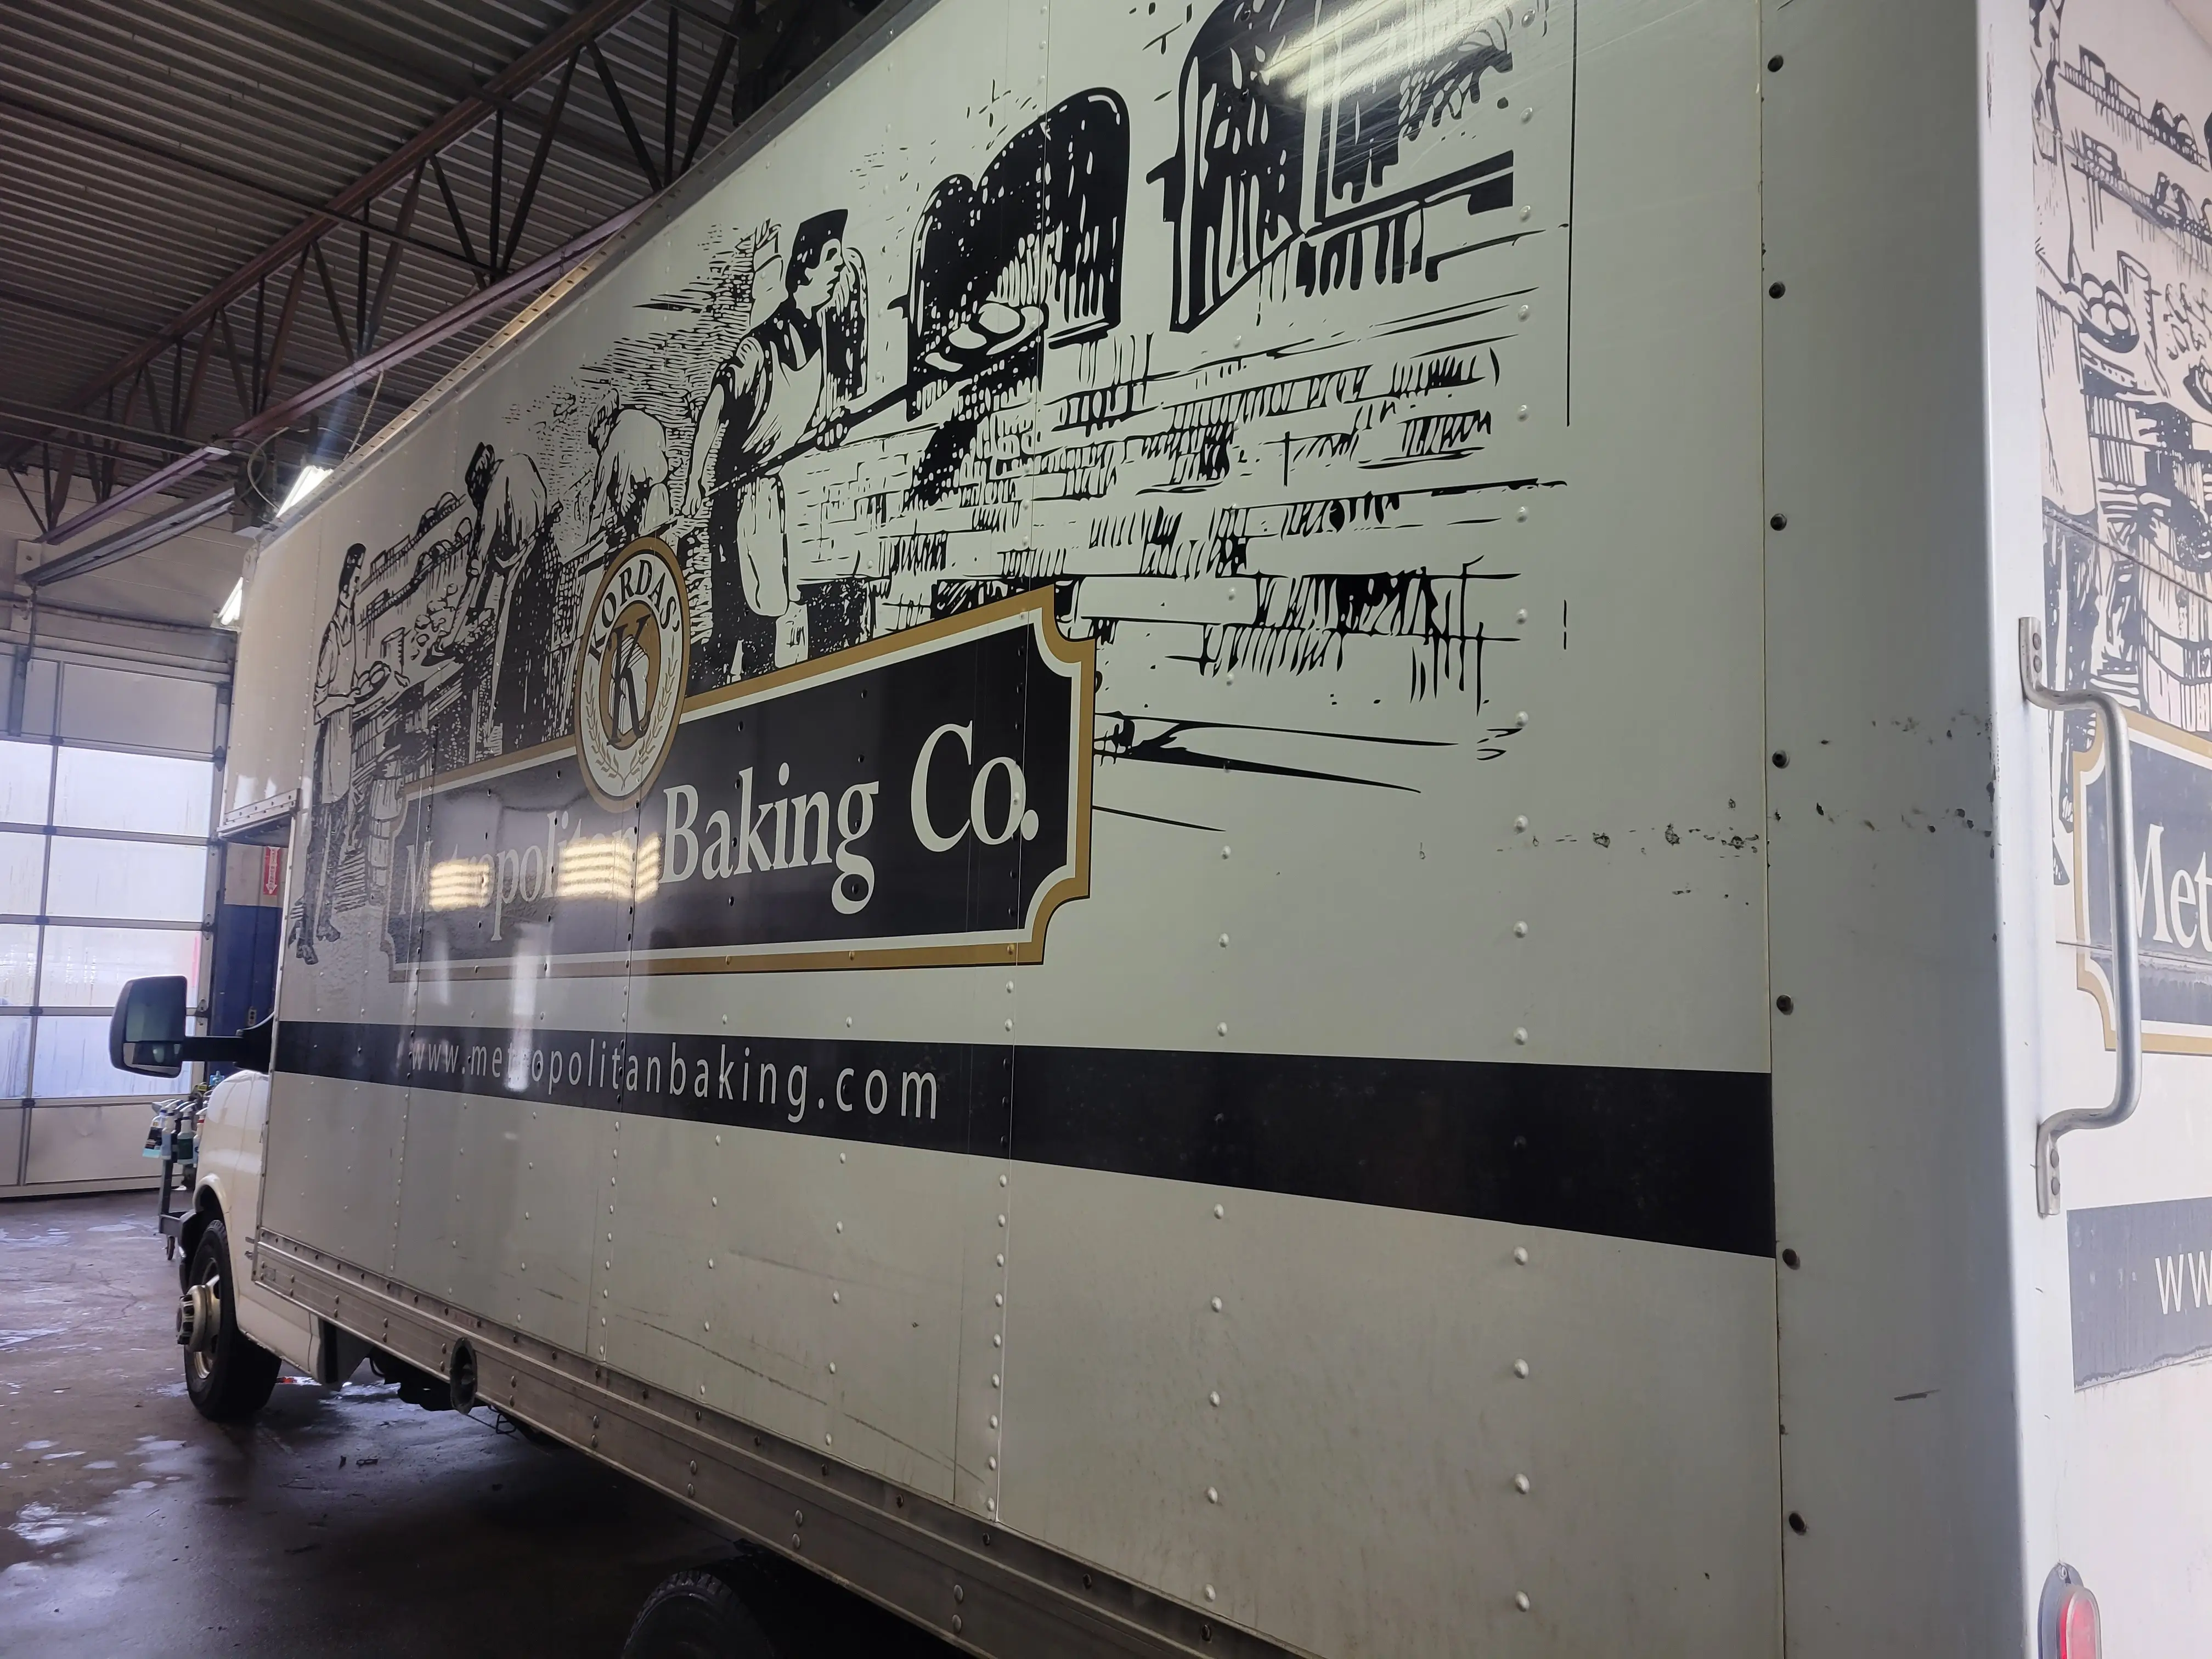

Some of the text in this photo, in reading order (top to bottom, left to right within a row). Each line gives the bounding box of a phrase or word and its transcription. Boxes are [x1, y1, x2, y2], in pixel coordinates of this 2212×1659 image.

[606, 613, 652, 746] K
[398, 720, 1039, 941] Mopoli Baking Co.
